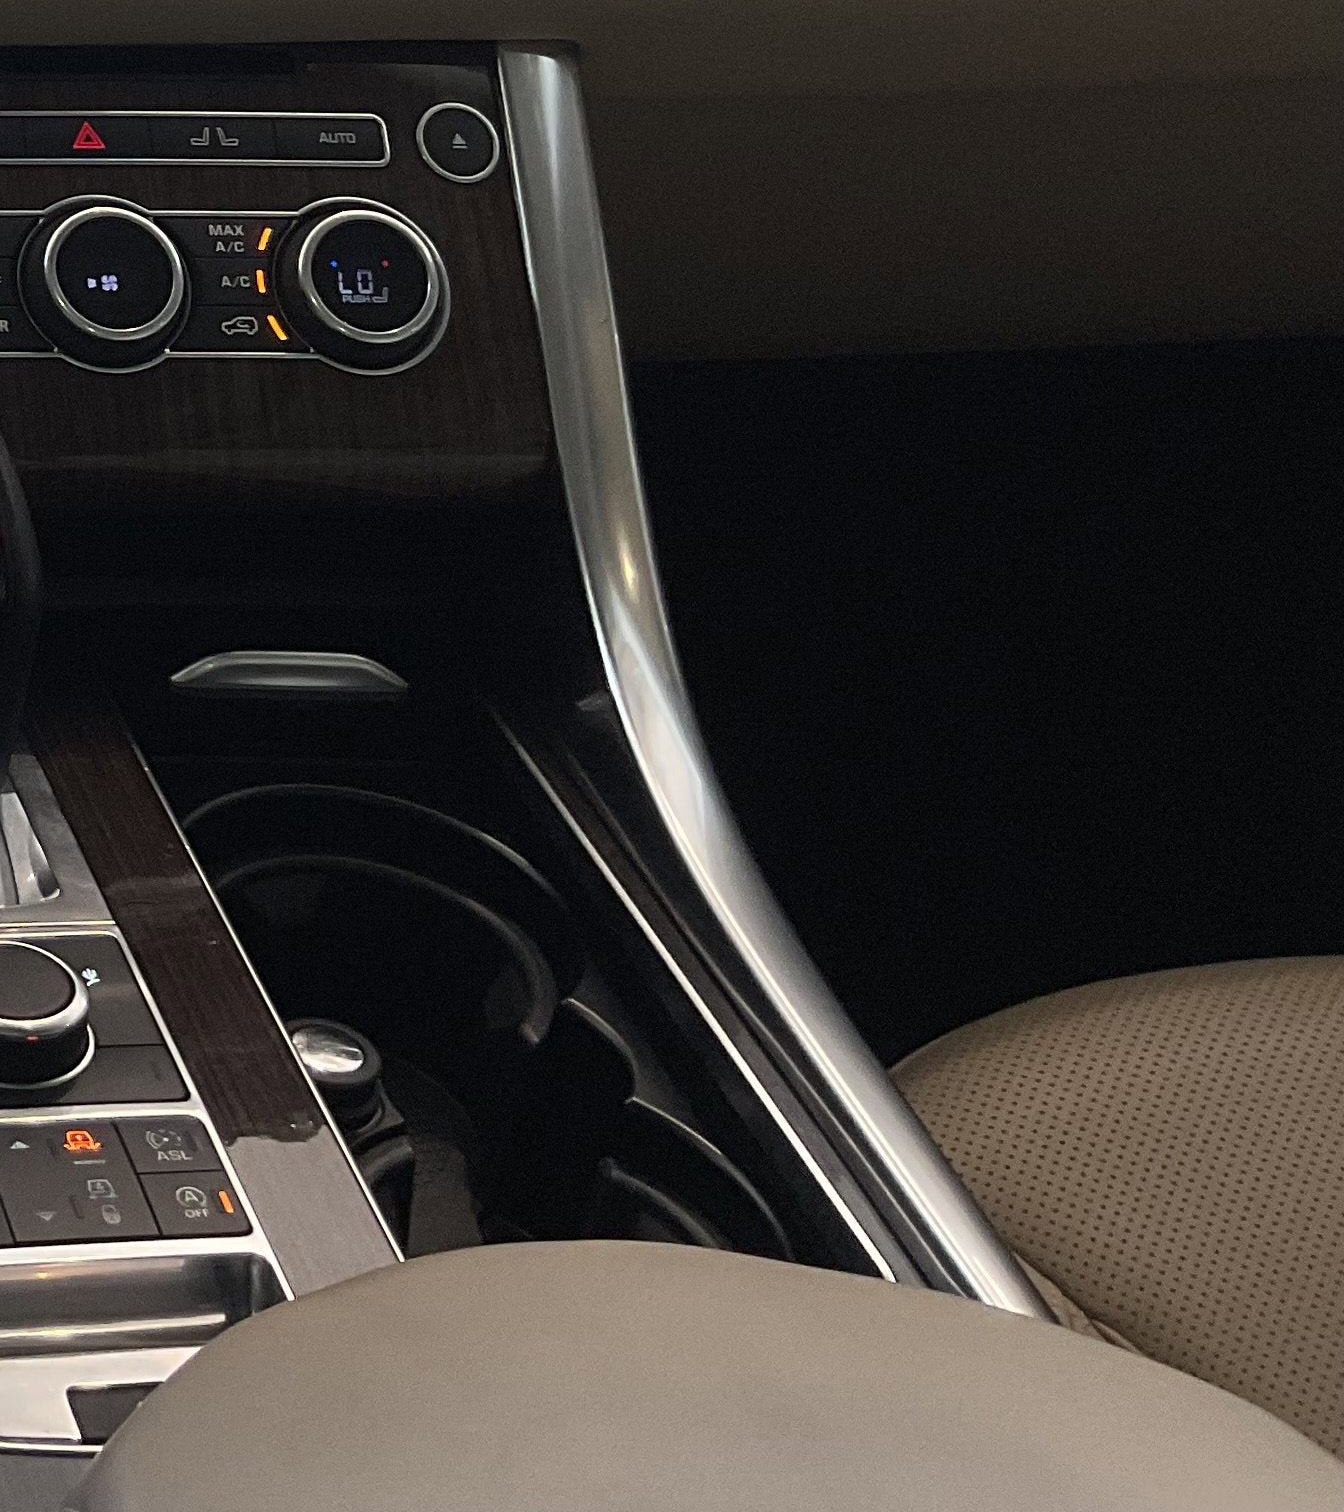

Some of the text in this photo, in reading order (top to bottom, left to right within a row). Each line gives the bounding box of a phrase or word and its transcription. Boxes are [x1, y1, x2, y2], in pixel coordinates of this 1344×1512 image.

[319, 132, 357, 144] AUTO
[208, 224, 245, 237] MAX
[215, 241, 245, 253] A/C
[220, 275, 251, 288] A/C
[0, 320, 10, 333] R
[157, 1150, 193, 1161] ASL
[184, 1207, 209, 1219] OFF
